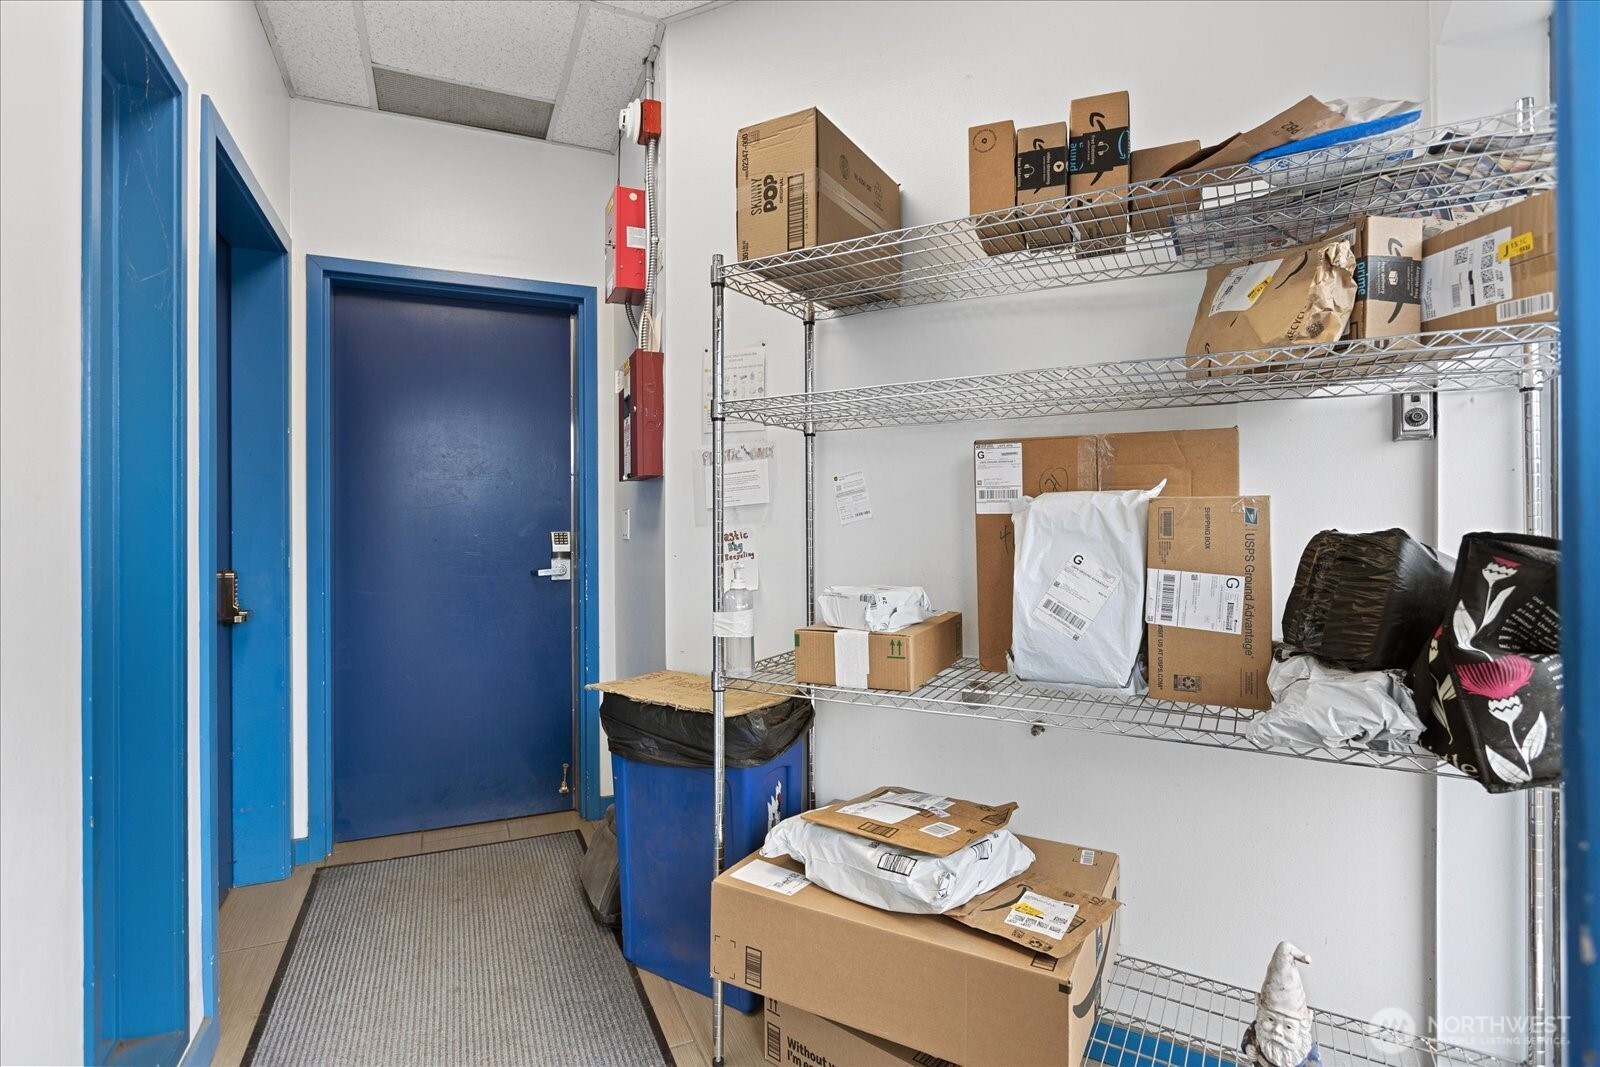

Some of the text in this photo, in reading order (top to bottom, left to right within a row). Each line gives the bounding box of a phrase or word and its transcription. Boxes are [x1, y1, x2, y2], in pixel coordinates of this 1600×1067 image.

[750, 178, 762, 216] SKINNY
[763, 174, 778, 213] POP
[1356, 262, 1370, 295] prime
[977, 451, 985, 460] G
[1072, 554, 1084, 565] G
[1245, 533, 1255, 562] USPS
[1225, 577, 1240, 589] G
[1245, 564, 1255, 600] Ground
[1158, 639, 1164, 648] US
[787, 1036, 827, 1067] Without
